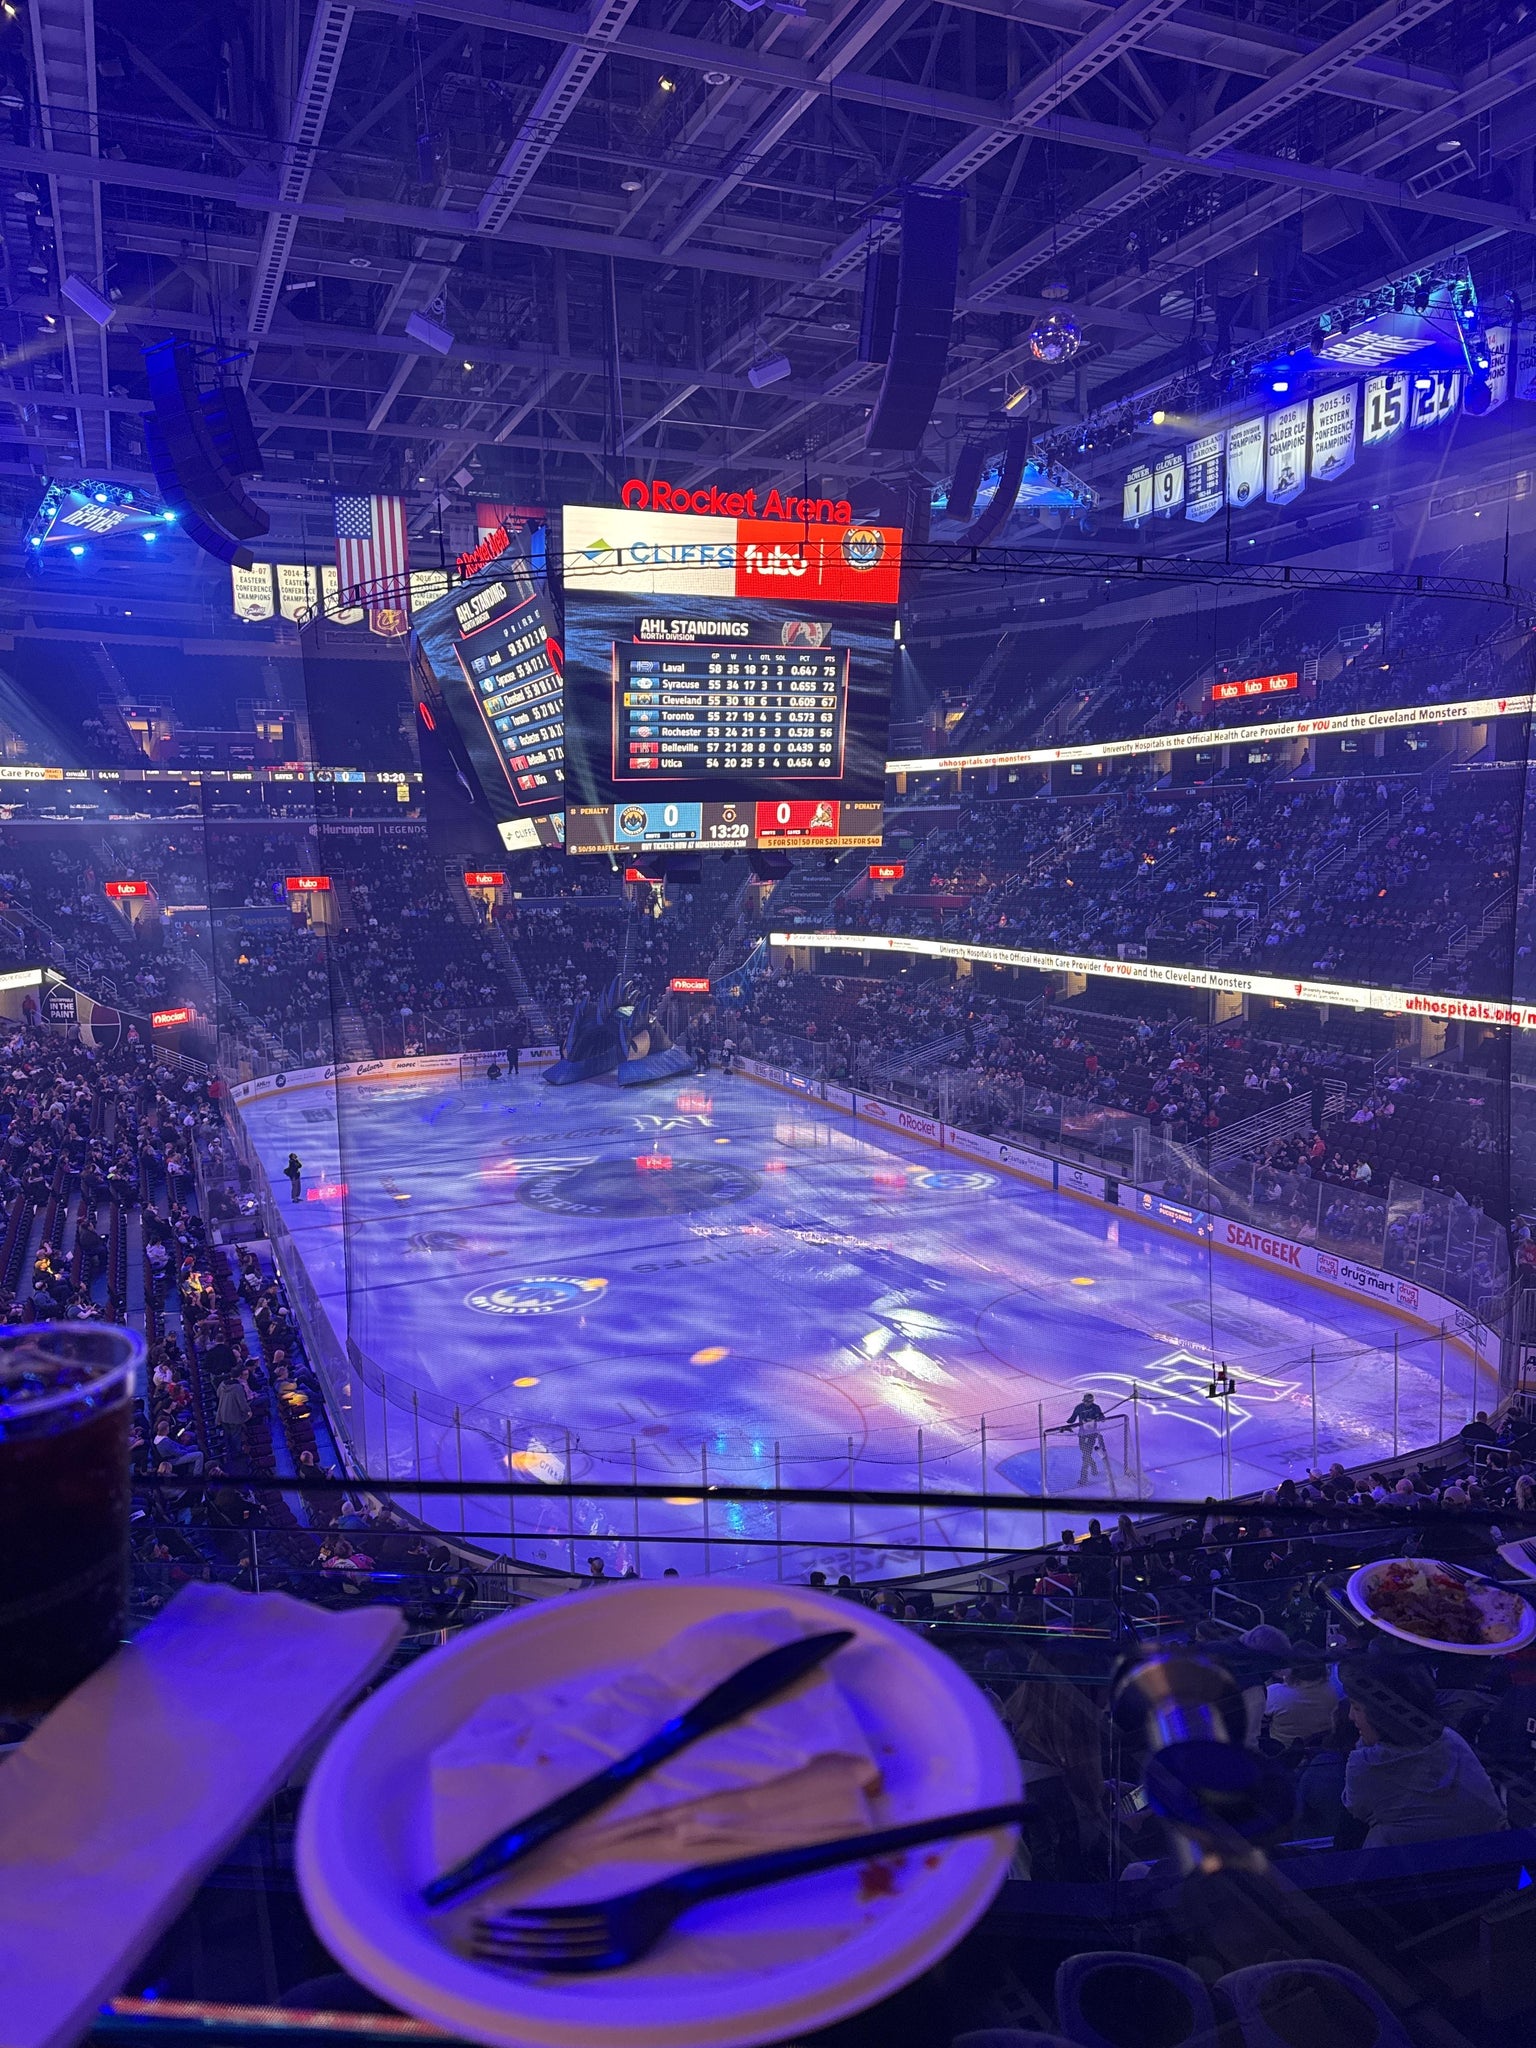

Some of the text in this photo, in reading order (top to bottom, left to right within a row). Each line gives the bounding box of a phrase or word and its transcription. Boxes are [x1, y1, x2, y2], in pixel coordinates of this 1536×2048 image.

[1347, 330, 1381, 349] THE
[1319, 393, 1351, 413] 2015-16
[1371, 387, 1402, 433] 15
[1279, 411, 1297, 426] 2016
[1319, 408, 1350, 428] WESTERN
[1269, 426, 1293, 444] CALDER
[1314, 419, 1354, 441] CONFERENCE
[1188, 430, 1224, 454] CLEVELAND
[1229, 431, 1262, 451] CHAMPIONS
[1269, 434, 1305, 457] CHAMPIONS
[1316, 433, 1351, 453] CHAMPIONS
[1192, 444, 1217, 459] BARONS
[1155, 455, 1182, 471] GLOVER
[1127, 467, 1150, 482] BOWER
[1163, 472, 1173, 503] 9
[652, 479, 853, 524] Rocket Arena
[1134, 484, 1141, 513] 1
[80, 502, 130, 521] FEAR THE
[60, 509, 122, 534] DEPTHS
[630, 541, 735, 569] CLIFFS
[744, 544, 808, 577] fubo
[239, 576, 267, 584] EASTERN
[235, 584, 273, 593] CONFERENCE
[237, 592, 271, 601] CHAMPIONS
[457, 602, 475, 624] AHL
[470, 581, 508, 616] STANDINGS
[640, 618, 749, 637] AHL STANDINGS
[640, 633, 696, 642] NORTH DIVISION
[662, 662, 836, 676] Laval 58 35 18 0.647 75
[662, 679, 834, 692] Syracuse 55 34 17 0.655 72
[1220, 677, 1288, 697] fubo fubo fubo
[662, 695, 834, 707] Cleveland 55 30 18 0.609 67
[661, 711, 833, 723] Toronto 55 27 19 0.573 63
[661, 727, 832, 738] Rochester 53 24 21 0.528 56
[1102, 743, 1134, 755] University
[1134, 739, 1165, 752] Hospitals
[1166, 739, 1173, 747] is
[1173, 737, 1185, 746] the
[1186, 733, 1213, 745] Official
[1214, 730, 1239, 741] Health
[1240, 728, 1258, 739] Care
[1260, 725, 1295, 738] Provider
[1297, 723, 1310, 733] for
[1312, 720, 1331, 731] YOU
[1331, 717, 1348, 729] and
[1351, 714, 1366, 727] the
[1368, 709, 1417, 725] Cleveland
[1418, 705, 1468, 720] Monsters
[661, 743, 831, 753] Belleville 57 21 28 0.439 50
[661, 758, 831, 768] Utica 54 20 25 0.454 49
[1, 769, 23, 778] Care
[297, 772, 304, 781] 0
[342, 772, 350, 781] 0
[376, 772, 406, 782] 13:20
[580, 807, 609, 815] PENALTY
[664, 804, 679, 828] 0
[776, 802, 791, 824] 0
[384, 825, 427, 834] LEGENDS
[514, 828, 537, 839] CLIFFS
[709, 824, 750, 840] 13:20
[787, 838, 798, 846] $10
[801, 838, 811, 846] 50
[476, 874, 493, 884] fubo
[878, 868, 894, 878] fubo
[117, 884, 136, 894] fubo
[298, 878, 318, 889] fubo
[939, 944, 1252, 990] University Hospitals is the Official Health Care Provider for YOU and the Cleveland Monsters
[683, 980, 707, 991] Rocket
[50, 1002, 74, 1010] IN THE
[51, 1010, 74, 1019] PAINT
[161, 1011, 186, 1023] Rocket
[396, 1061, 416, 1069] NOPEC
[905, 1114, 936, 1137] Rocket
[1226, 1223, 1302, 1267] SEATGEEK
[1319, 1255, 1335, 1268] drug
[1319, 1265, 1338, 1277] mart
[1340, 1265, 1366, 1287] drug
[1367, 1276, 1395, 1295] mart
[1399, 1284, 1416, 1299] drug
[1400, 1293, 1418, 1308] mart
